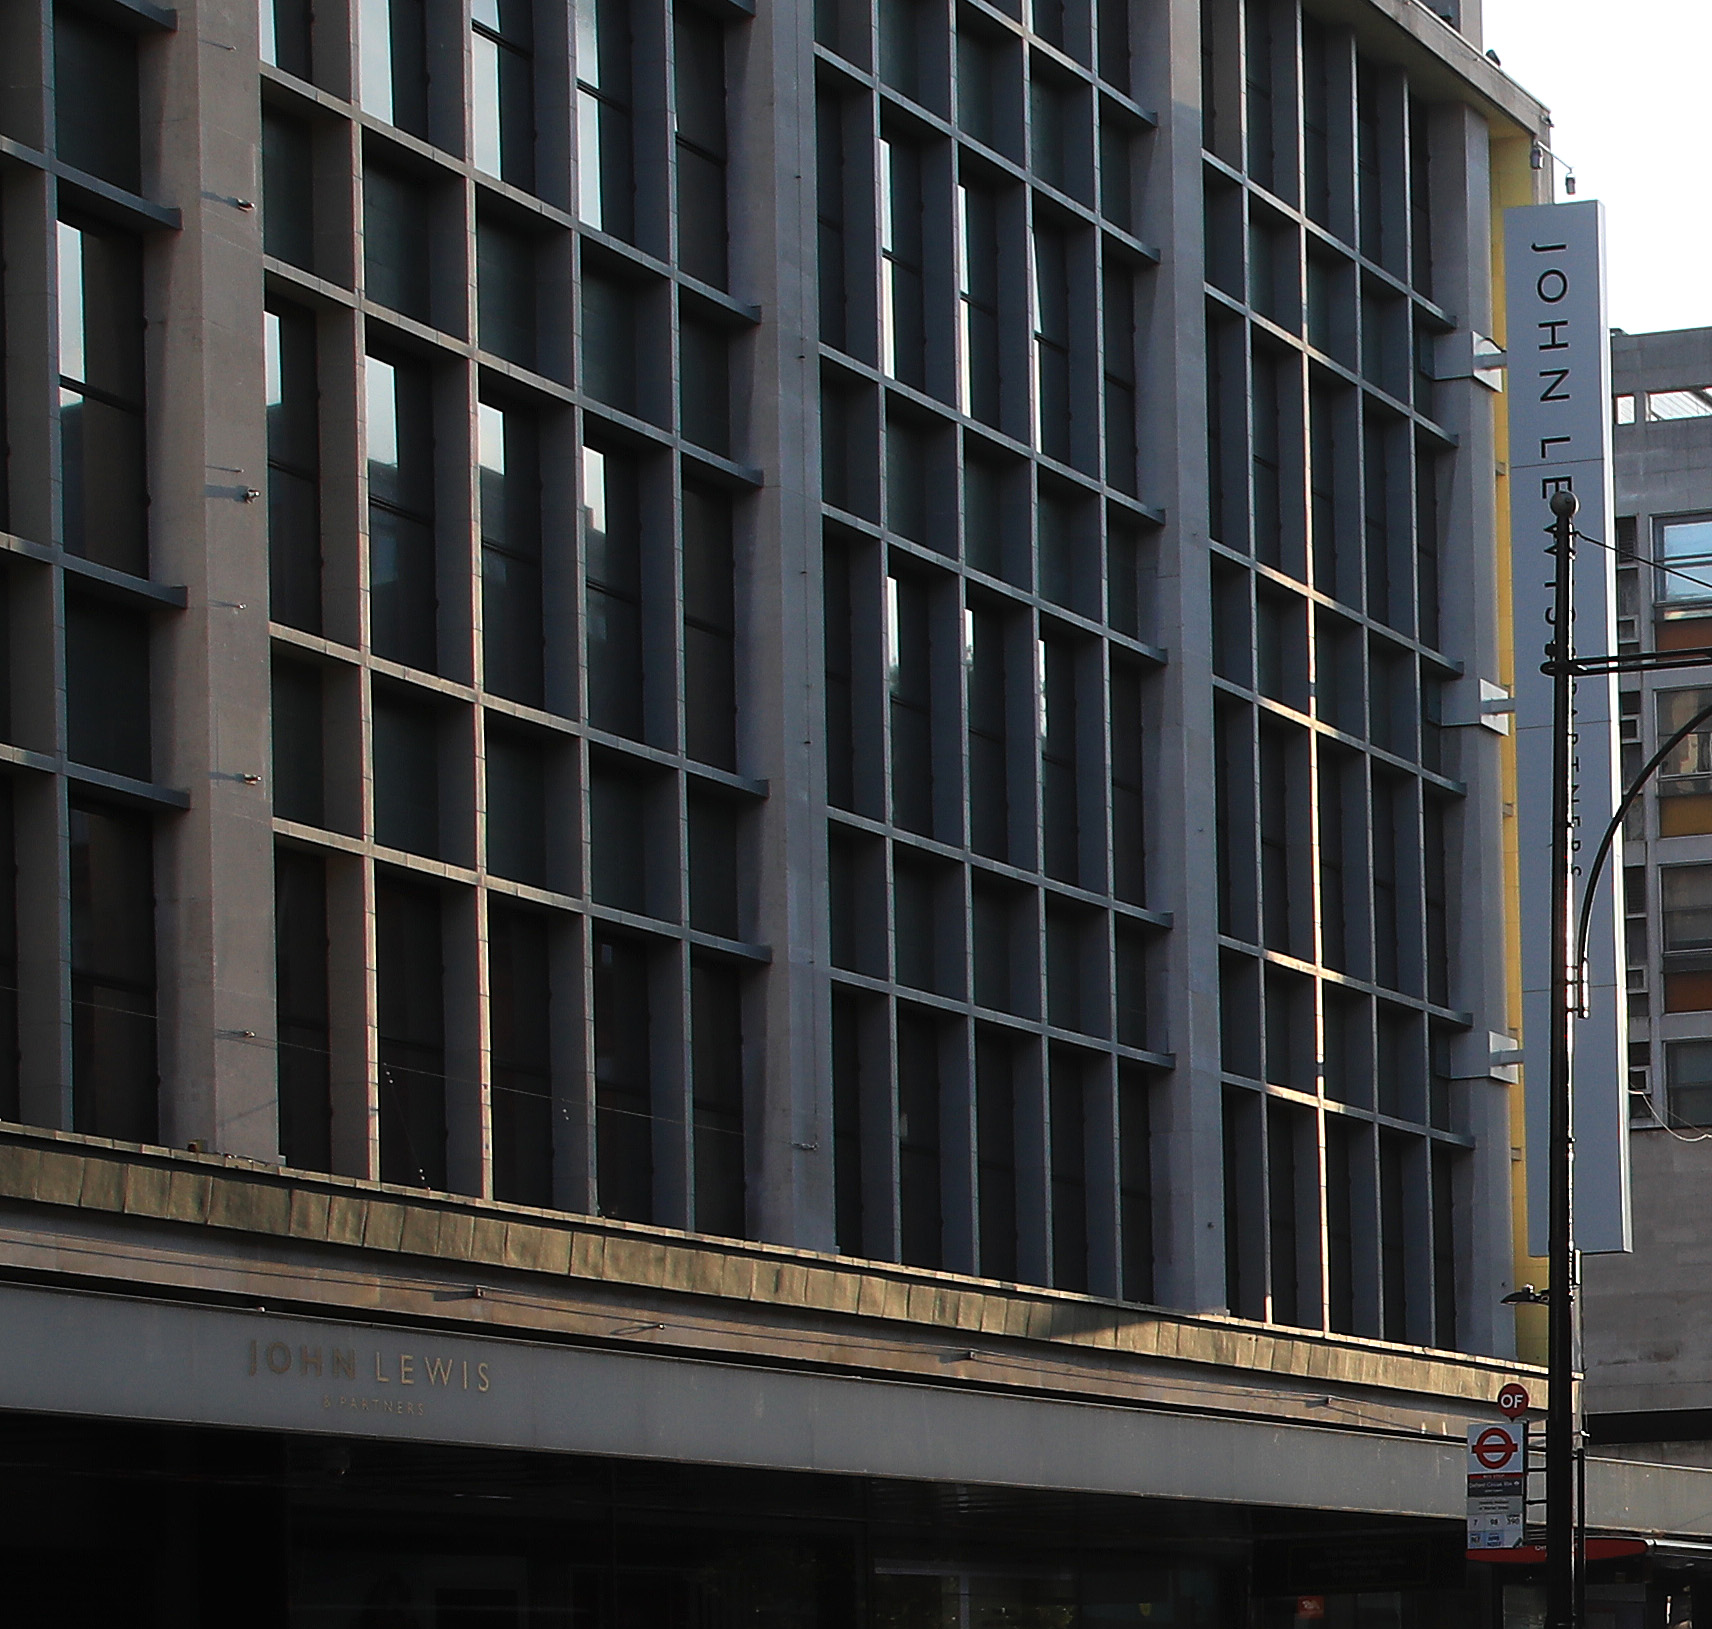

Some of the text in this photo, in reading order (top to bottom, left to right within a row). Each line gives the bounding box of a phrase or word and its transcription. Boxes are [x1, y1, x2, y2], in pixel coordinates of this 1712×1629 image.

[1531, 242, 1571, 402] JOHN
[248, 1339, 491, 1393] JOHN LEWIS
[339, 1395, 425, 1416] PARTNERS
[1500, 1393, 1524, 1409] OF
